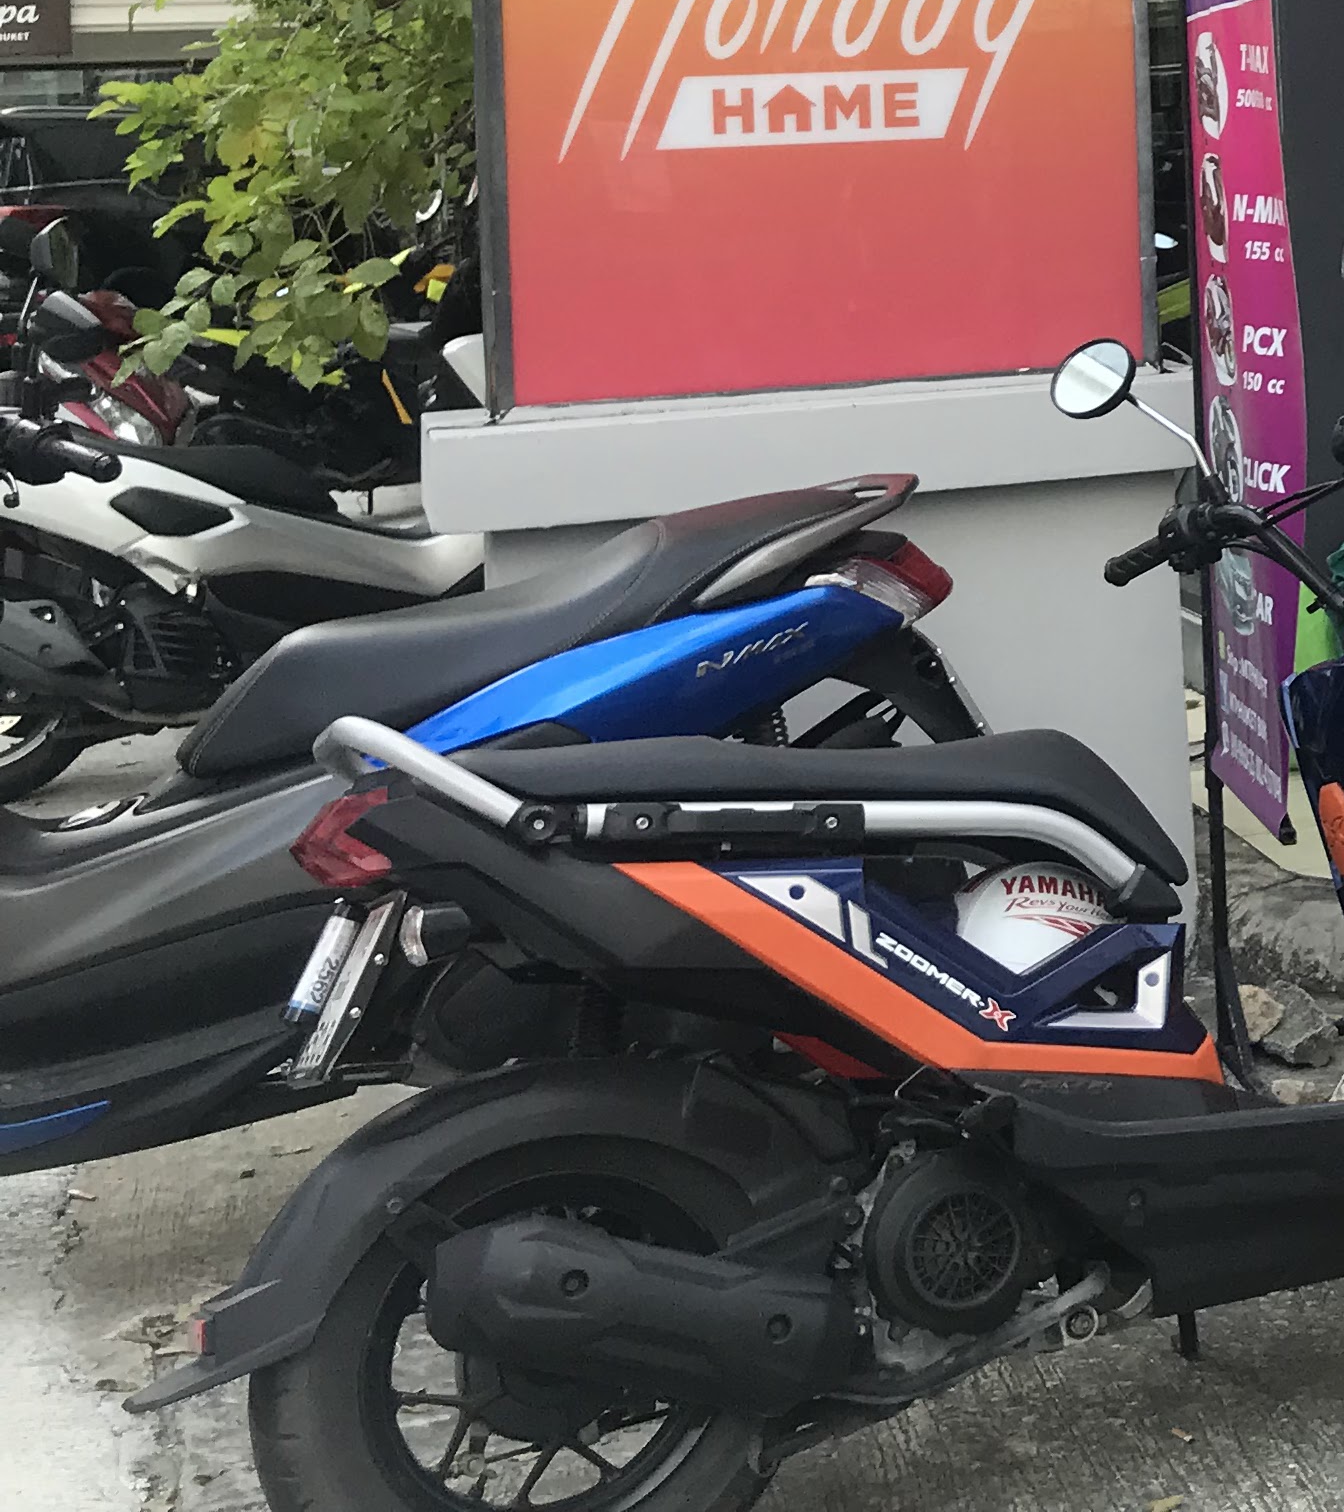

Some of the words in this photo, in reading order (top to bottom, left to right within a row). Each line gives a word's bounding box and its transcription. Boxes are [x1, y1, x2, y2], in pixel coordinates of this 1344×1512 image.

[0, 31, 31, 41] UKET
[1232, 194, 1286, 227] N-MA
[1245, 240, 1271, 261] 155
[1274, 247, 1285, 263] cc
[1242, 324, 1288, 357] PCX
[1242, 370, 1263, 392] 150
[1267, 378, 1286, 395] cc
